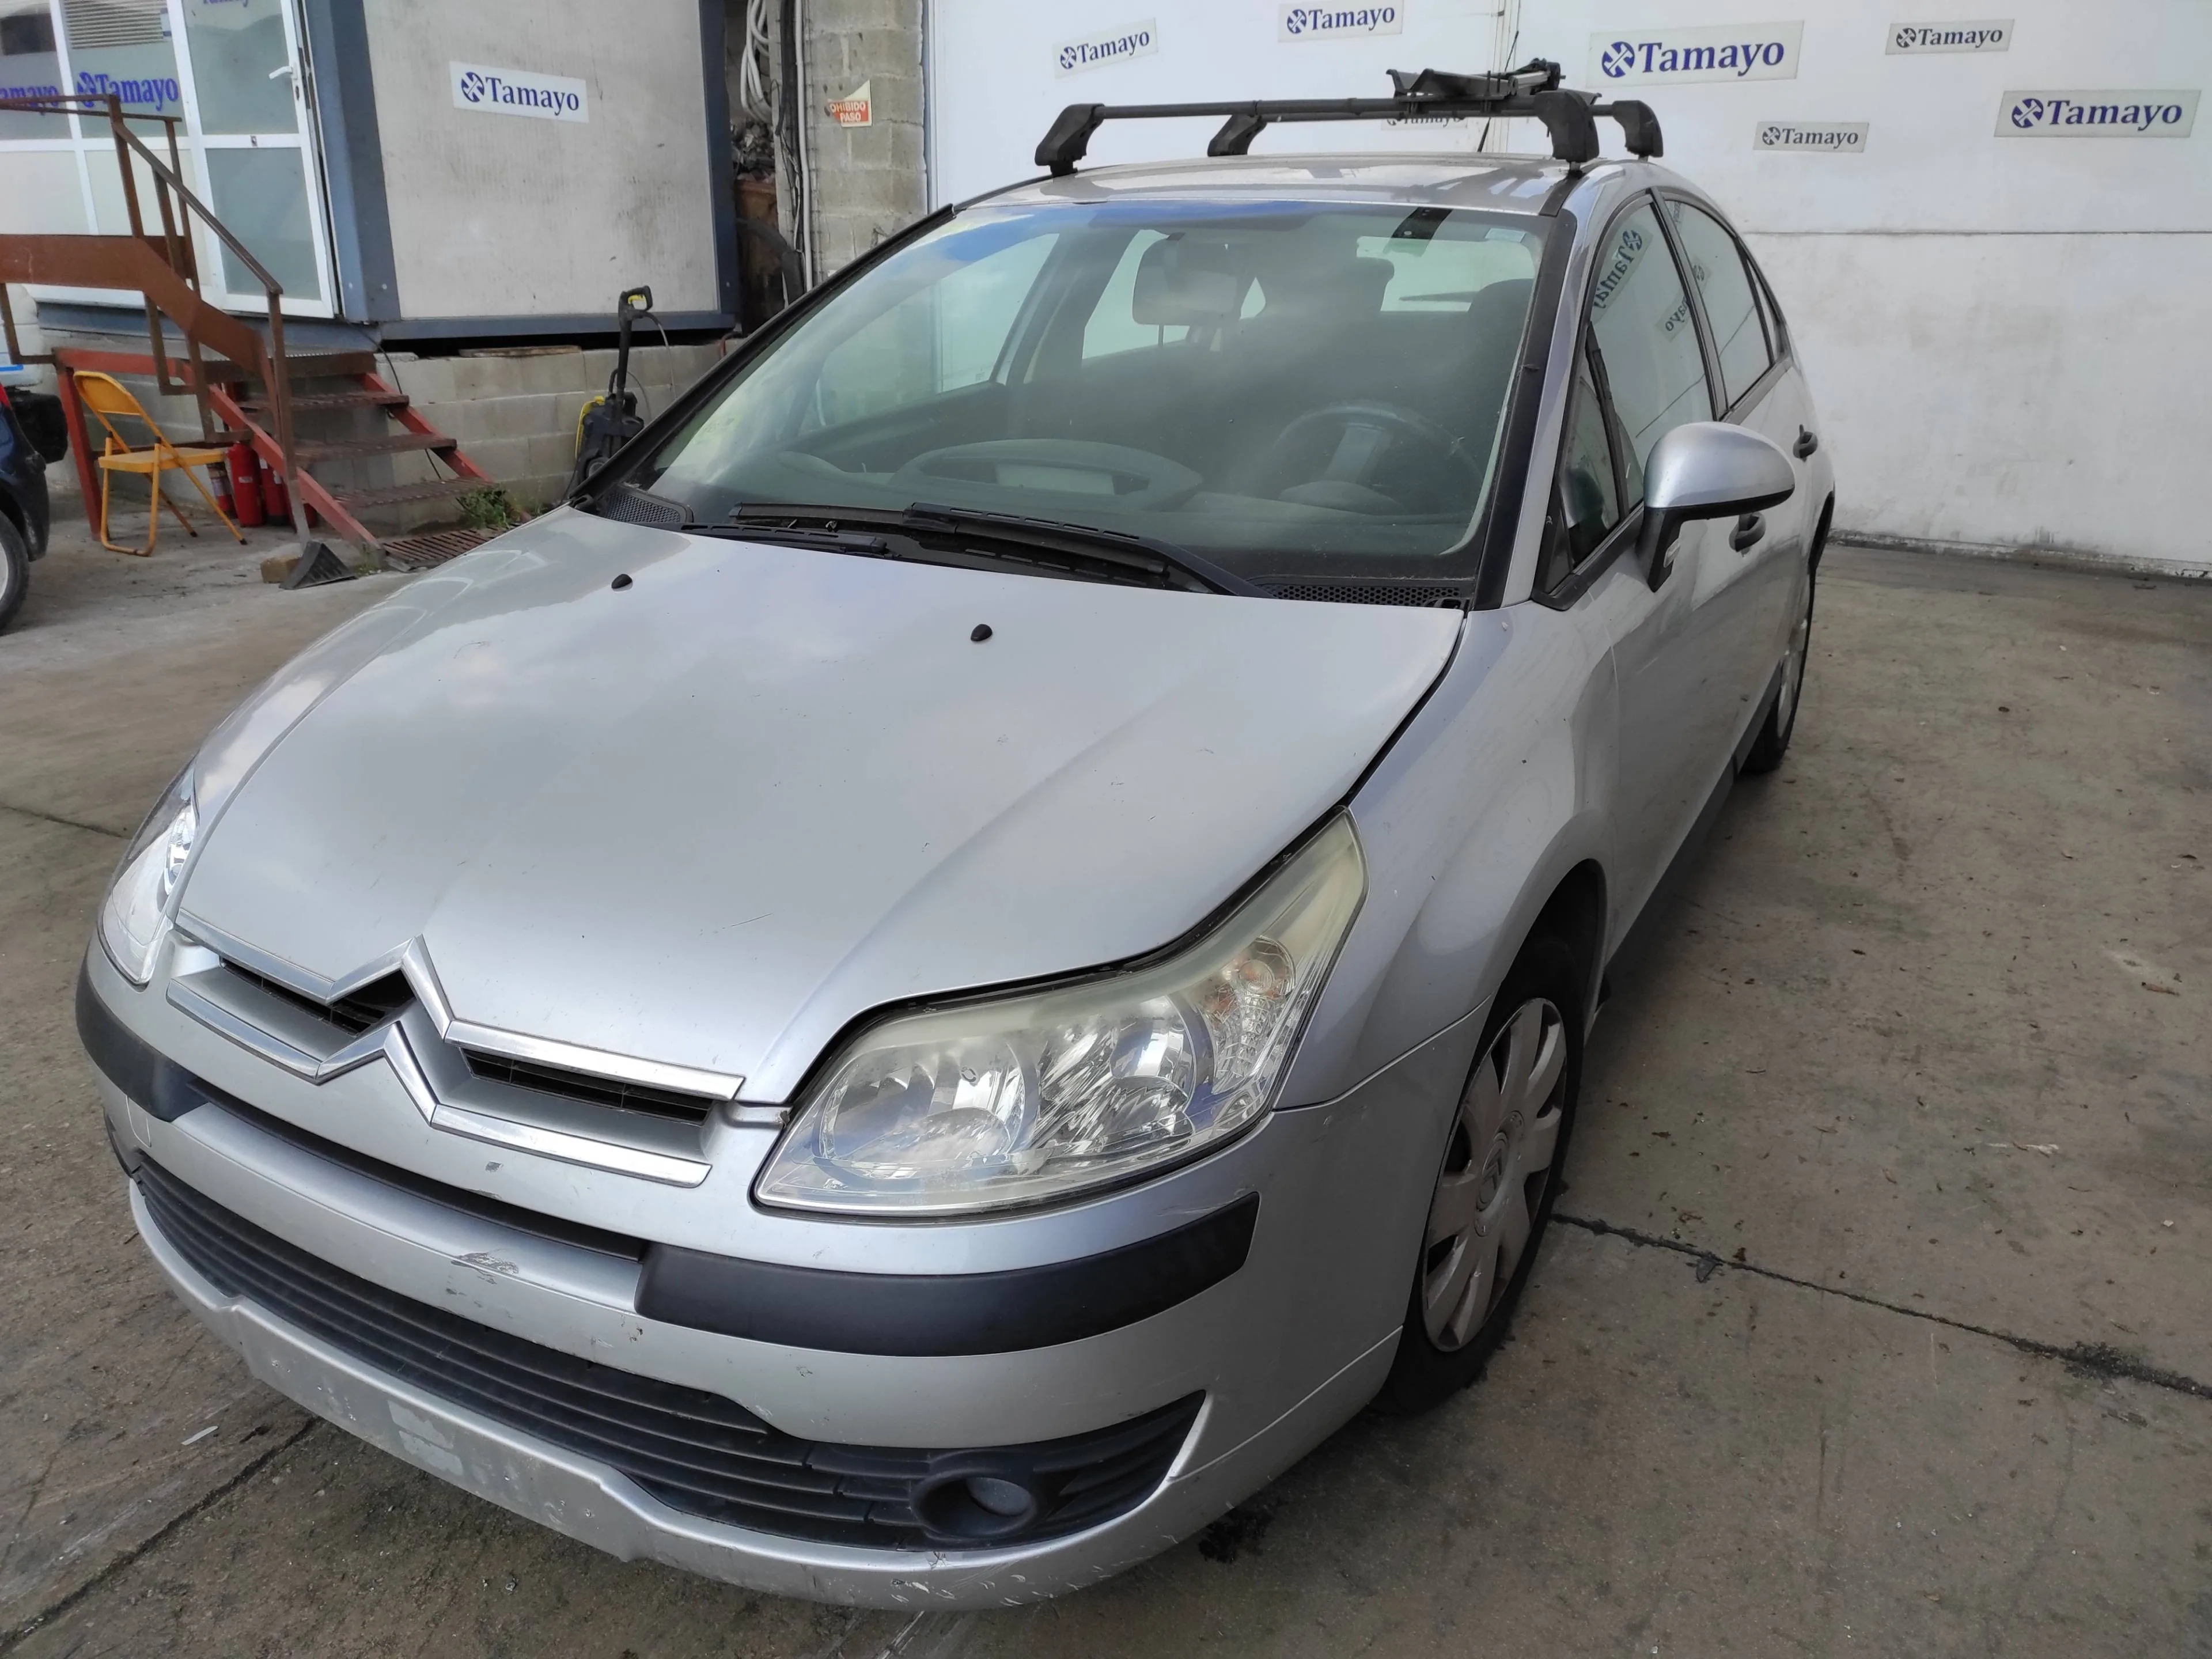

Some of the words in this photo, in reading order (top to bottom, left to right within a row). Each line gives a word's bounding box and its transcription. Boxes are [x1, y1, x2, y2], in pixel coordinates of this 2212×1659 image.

[1308, 7, 1395, 31] Tamayo
[1077, 31, 1150, 63] Tamayo
[1918, 28, 2003, 48] Tamayo
[1638, 42, 1784, 77] Tamayo
[94, 73, 179, 112] Tamayo
[485, 77, 579, 116] Tamayo
[840, 112, 861, 123] PASO
[2047, 100, 2182, 131] Tamayo
[1782, 128, 1859, 149] Tamayo
